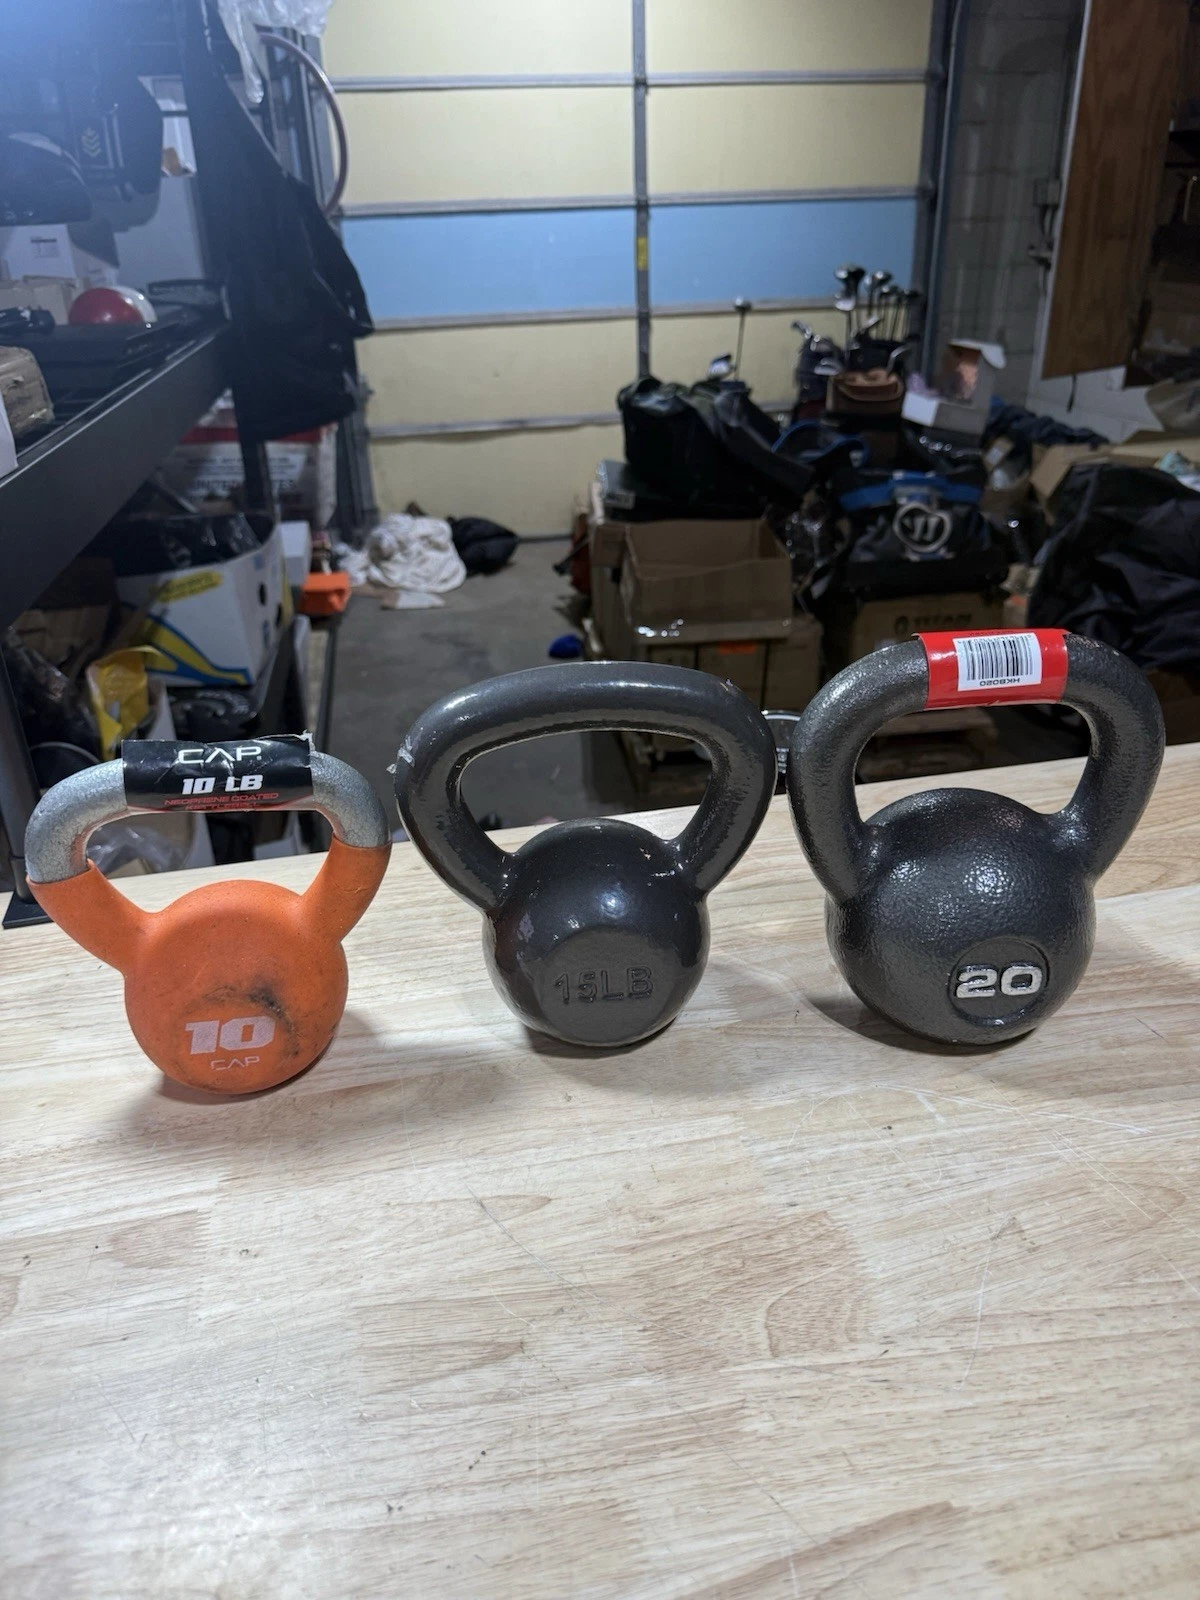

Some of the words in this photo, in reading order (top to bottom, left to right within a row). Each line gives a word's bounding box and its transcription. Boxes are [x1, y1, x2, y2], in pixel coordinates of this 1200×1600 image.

[979, 677, 1021, 687] HKB020
[177, 745, 262, 764] CAP
[181, 776, 216, 795] 10
[224, 774, 264, 793] LB
[164, 796, 231, 805] NEOPRENE
[231, 792, 279, 802] COATED
[956, 964, 1042, 998] 20
[184, 1015, 276, 1055] 10
[210, 1055, 260, 1071] CAP
